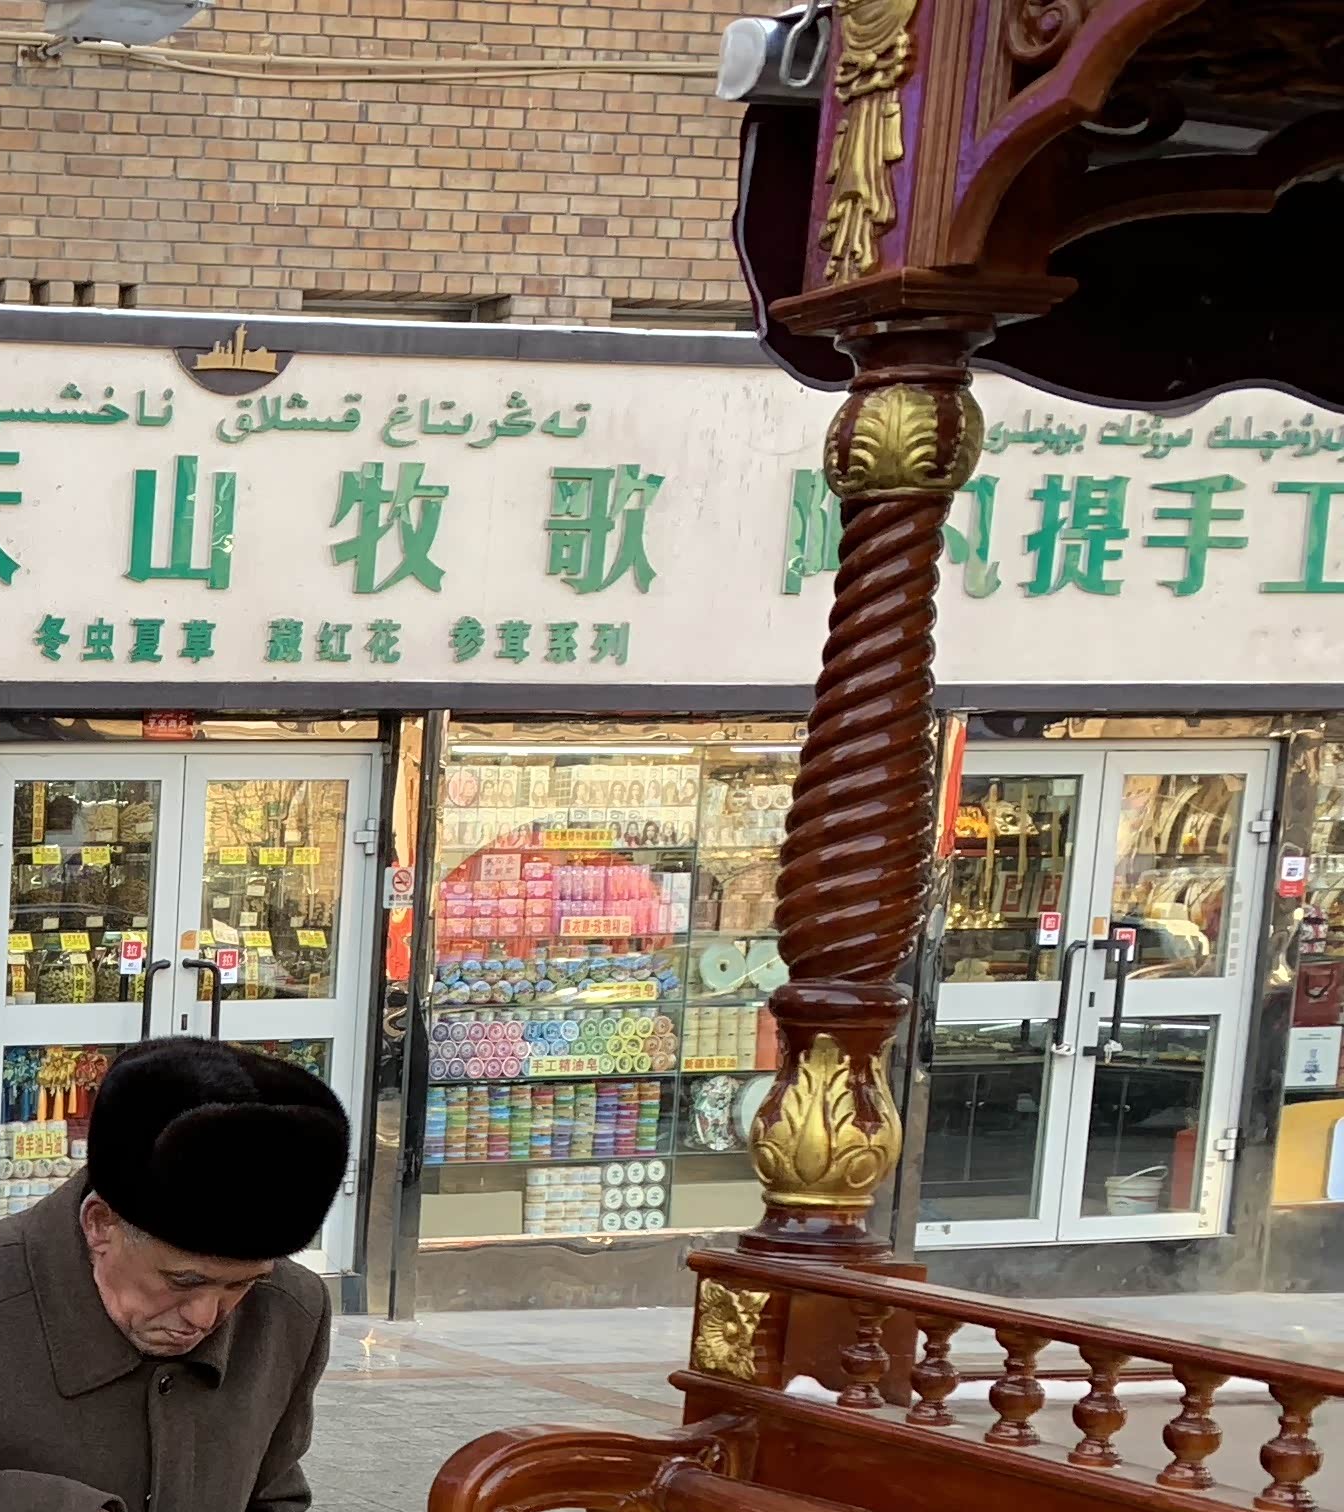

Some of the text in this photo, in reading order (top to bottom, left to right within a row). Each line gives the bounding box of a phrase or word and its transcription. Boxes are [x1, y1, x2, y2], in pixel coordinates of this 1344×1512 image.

[34, 614, 217, 664] 冬虫夏草
[265, 617, 403, 666] 藏红花
[449, 616, 632, 665] 参茸系列
[126, 944, 139, 958] 拉
[221, 953, 234, 967] 拉
[531, 1059, 599, 1074] 手工精油皂
